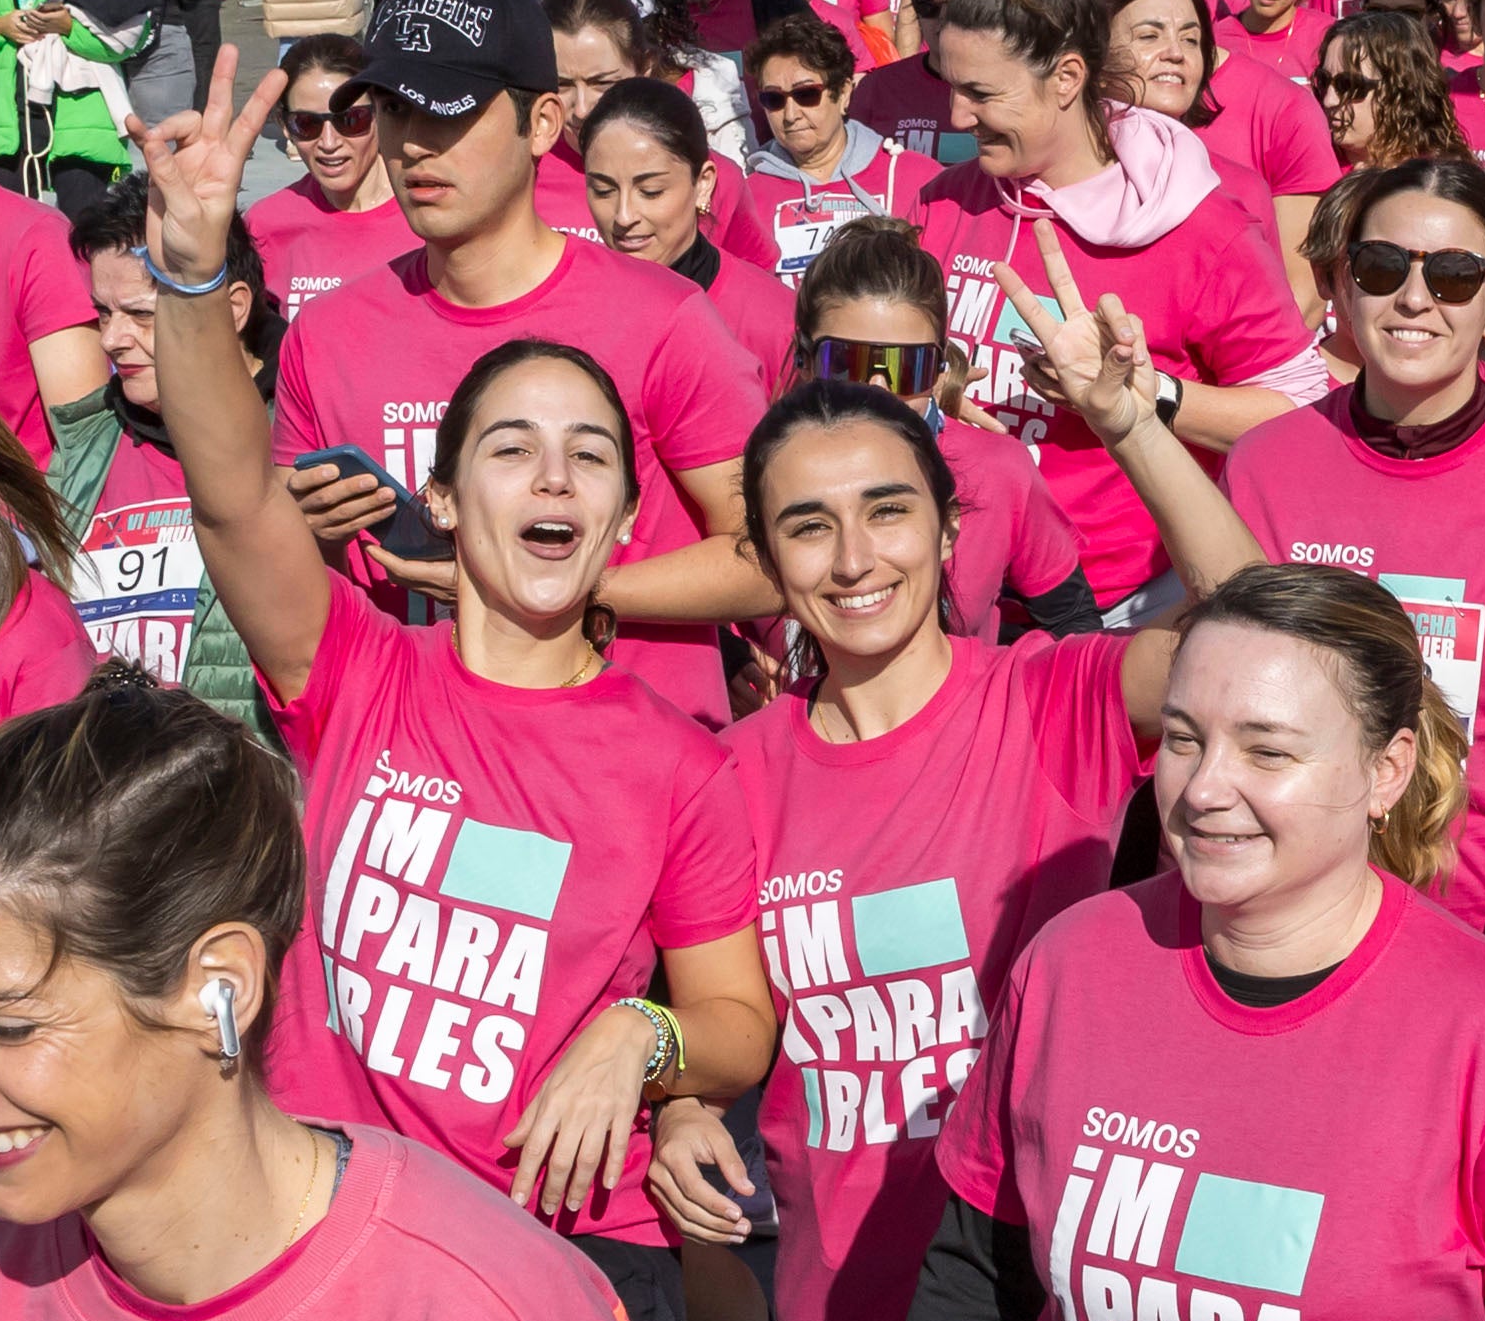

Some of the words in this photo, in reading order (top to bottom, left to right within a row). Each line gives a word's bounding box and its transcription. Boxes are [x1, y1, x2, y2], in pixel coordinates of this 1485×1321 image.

[398, 84, 426, 105] LOS
[430, 94, 477, 115] ANGELES
[897, 118, 937, 129] SOMOS
[290, 277, 342, 291] SOMOS
[127, 513, 145, 531] VI
[145, 508, 193, 528] MARC
[116, 546, 170, 592] 91
[1290, 542, 1375, 567] SOMOS
[758, 868, 844, 906] SOMOS
[339, 872, 548, 1017] PARA
[798, 965, 989, 1064] PARA
[1082, 1105, 1200, 1159] SOMOS
